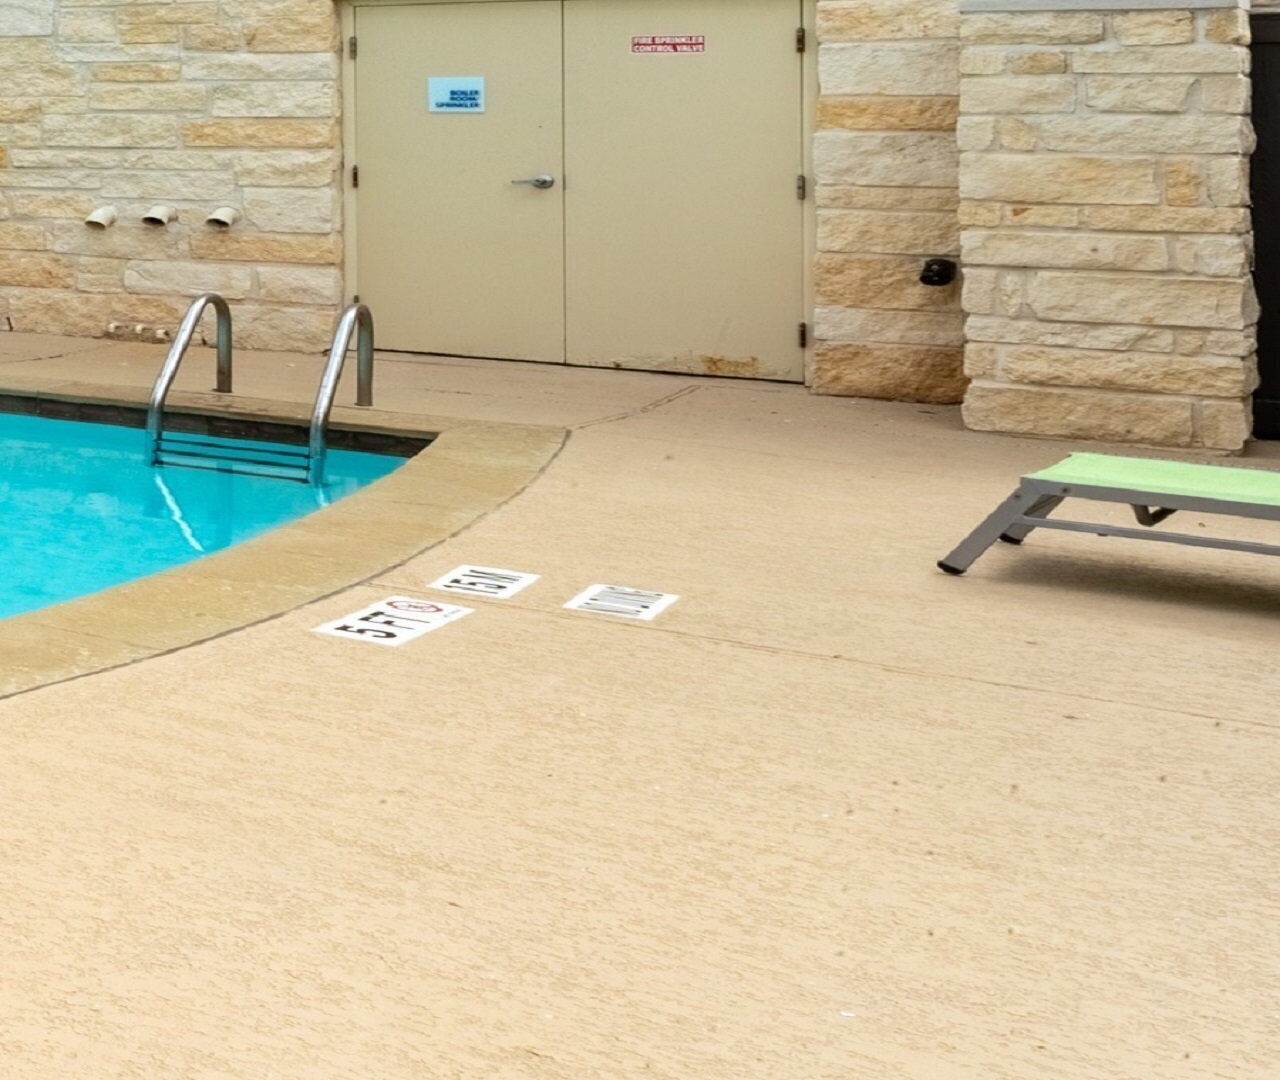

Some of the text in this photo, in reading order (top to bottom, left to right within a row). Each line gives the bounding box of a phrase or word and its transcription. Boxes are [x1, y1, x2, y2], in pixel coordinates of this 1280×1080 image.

[633, 36, 704, 44] FIRE SPRINKLER
[633, 44, 704, 52] CONTROL VALVE
